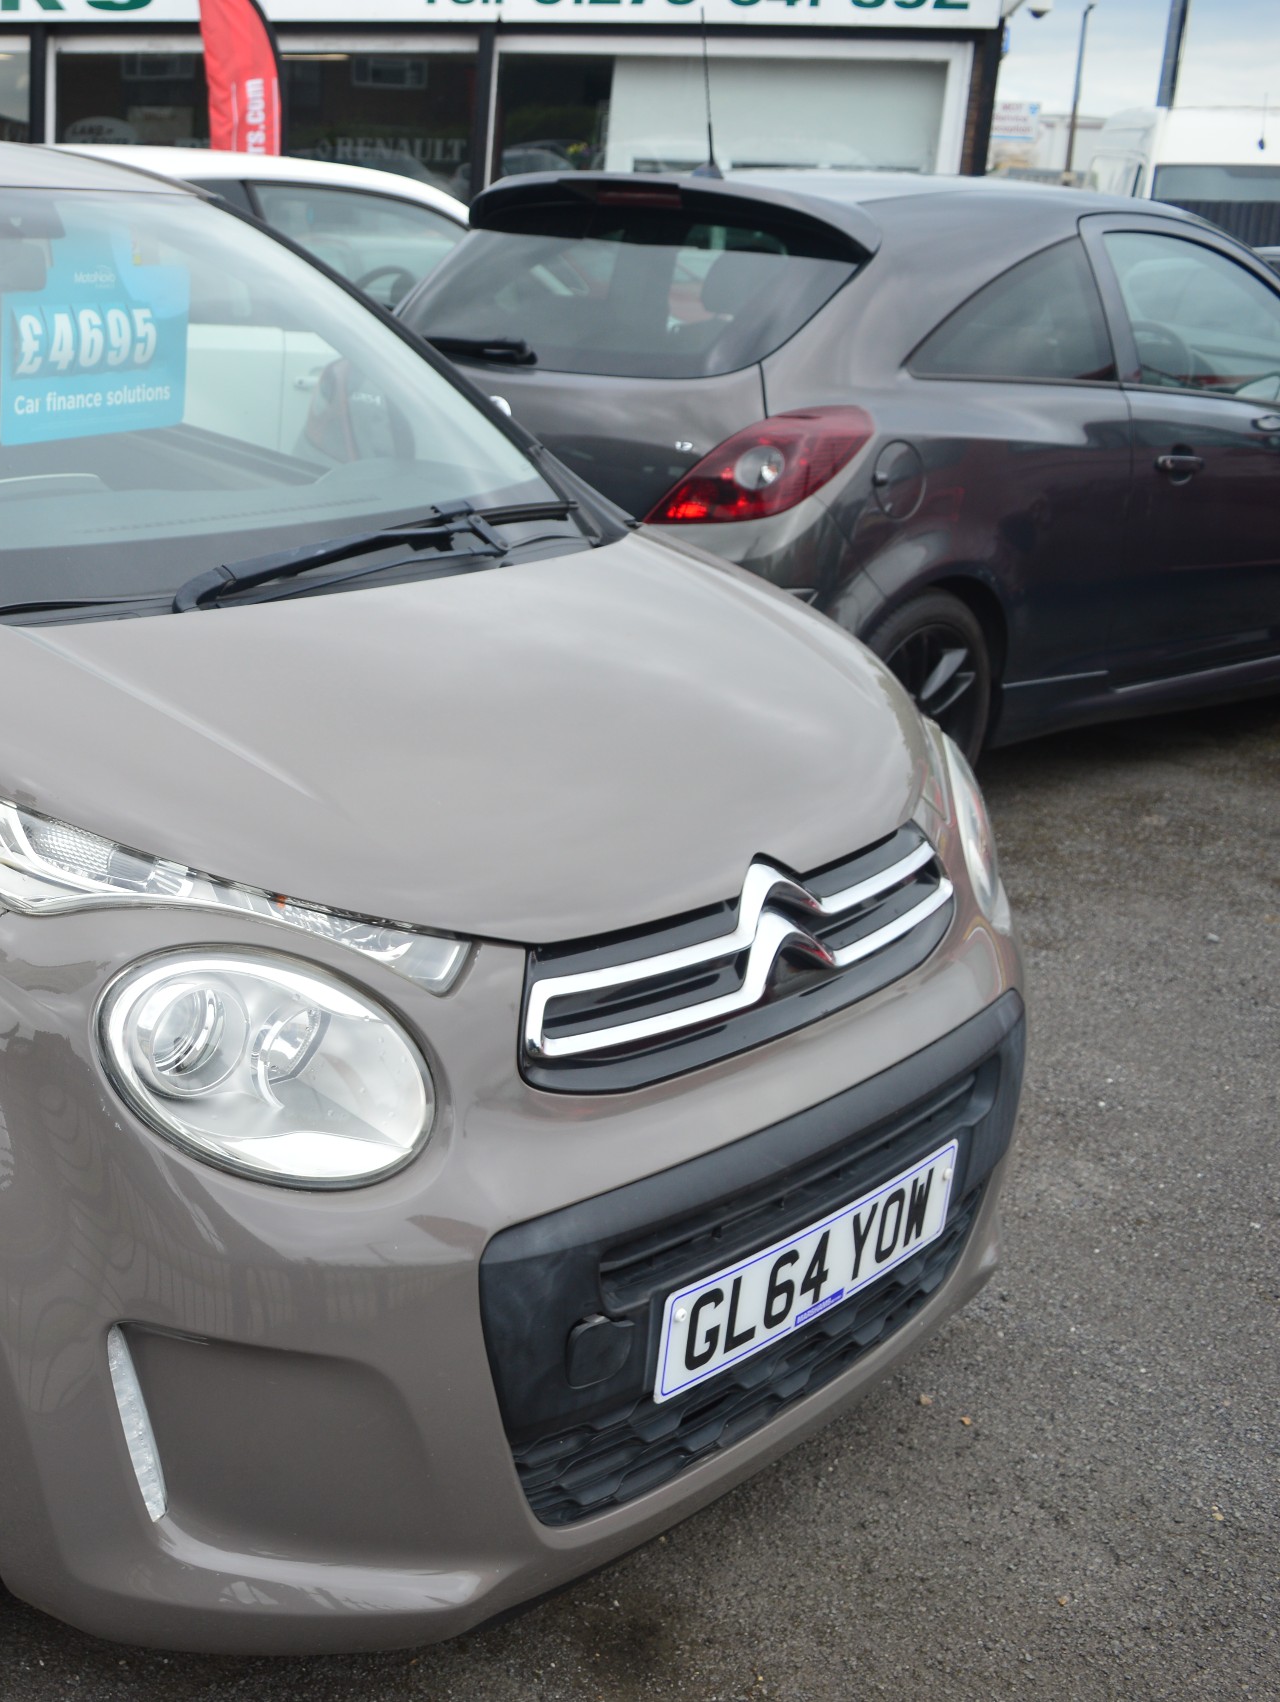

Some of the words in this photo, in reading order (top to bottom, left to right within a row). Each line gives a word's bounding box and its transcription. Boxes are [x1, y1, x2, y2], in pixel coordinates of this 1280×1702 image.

[335, 136, 468, 162] RENAULT
[15, 307, 157, 375] £4695
[14, 394, 41, 415] Car
[46, 391, 102, 412] finance
[107, 384, 171, 406] solutions
[684, 1229, 831, 1372] GL64
[851, 1166, 935, 1282] YOW
